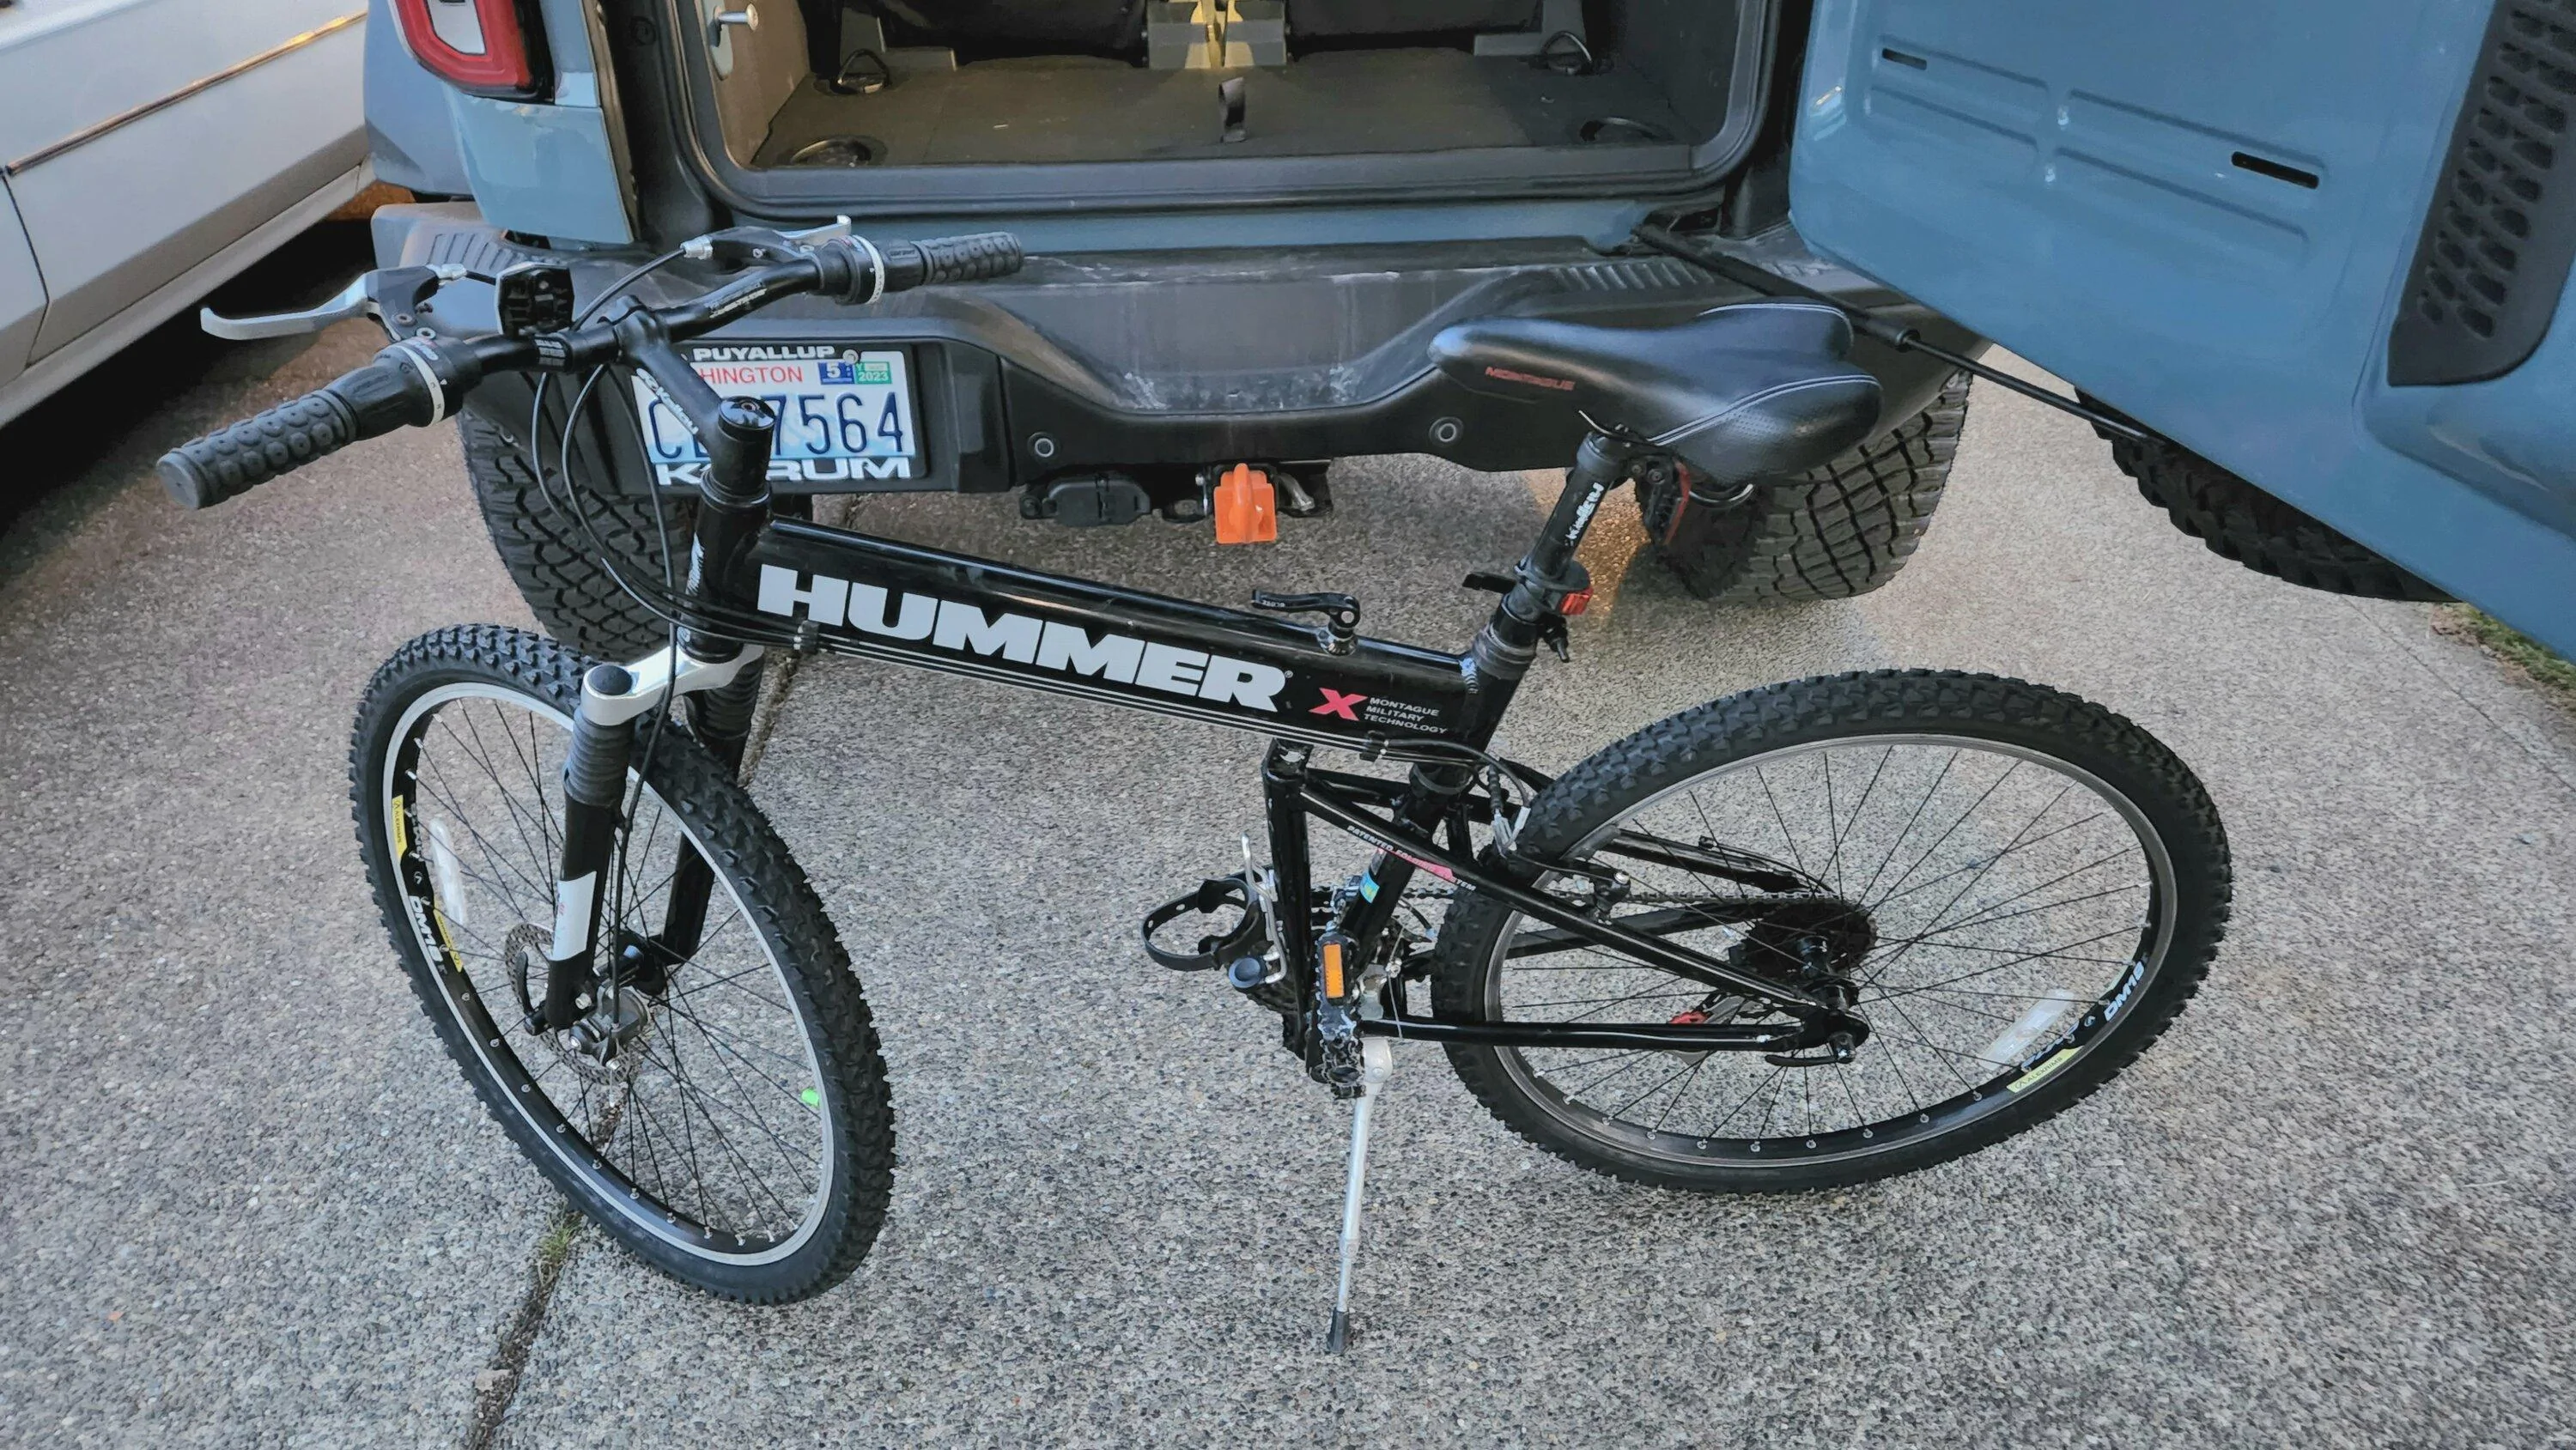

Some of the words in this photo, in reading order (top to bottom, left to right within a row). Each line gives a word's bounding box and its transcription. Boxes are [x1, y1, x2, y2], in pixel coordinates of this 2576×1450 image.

[692, 346, 835, 361] PUYALLUP
[699, 366, 804, 384] HINGTON
[826, 361, 841, 379] 5
[858, 371, 890, 382] 2023
[648, 391, 903, 459] C7564
[655, 457, 912, 486] KRUM
[757, 563, 1285, 713] HUMMER
[1308, 687, 1368, 721] X
[1365, 705, 1425, 722] MILITARY
[1370, 696, 1441, 717] MONTAGUE
[1363, 713, 1449, 735] TECHNOLOGY
[1346, 824, 1394, 852] PATENTED
